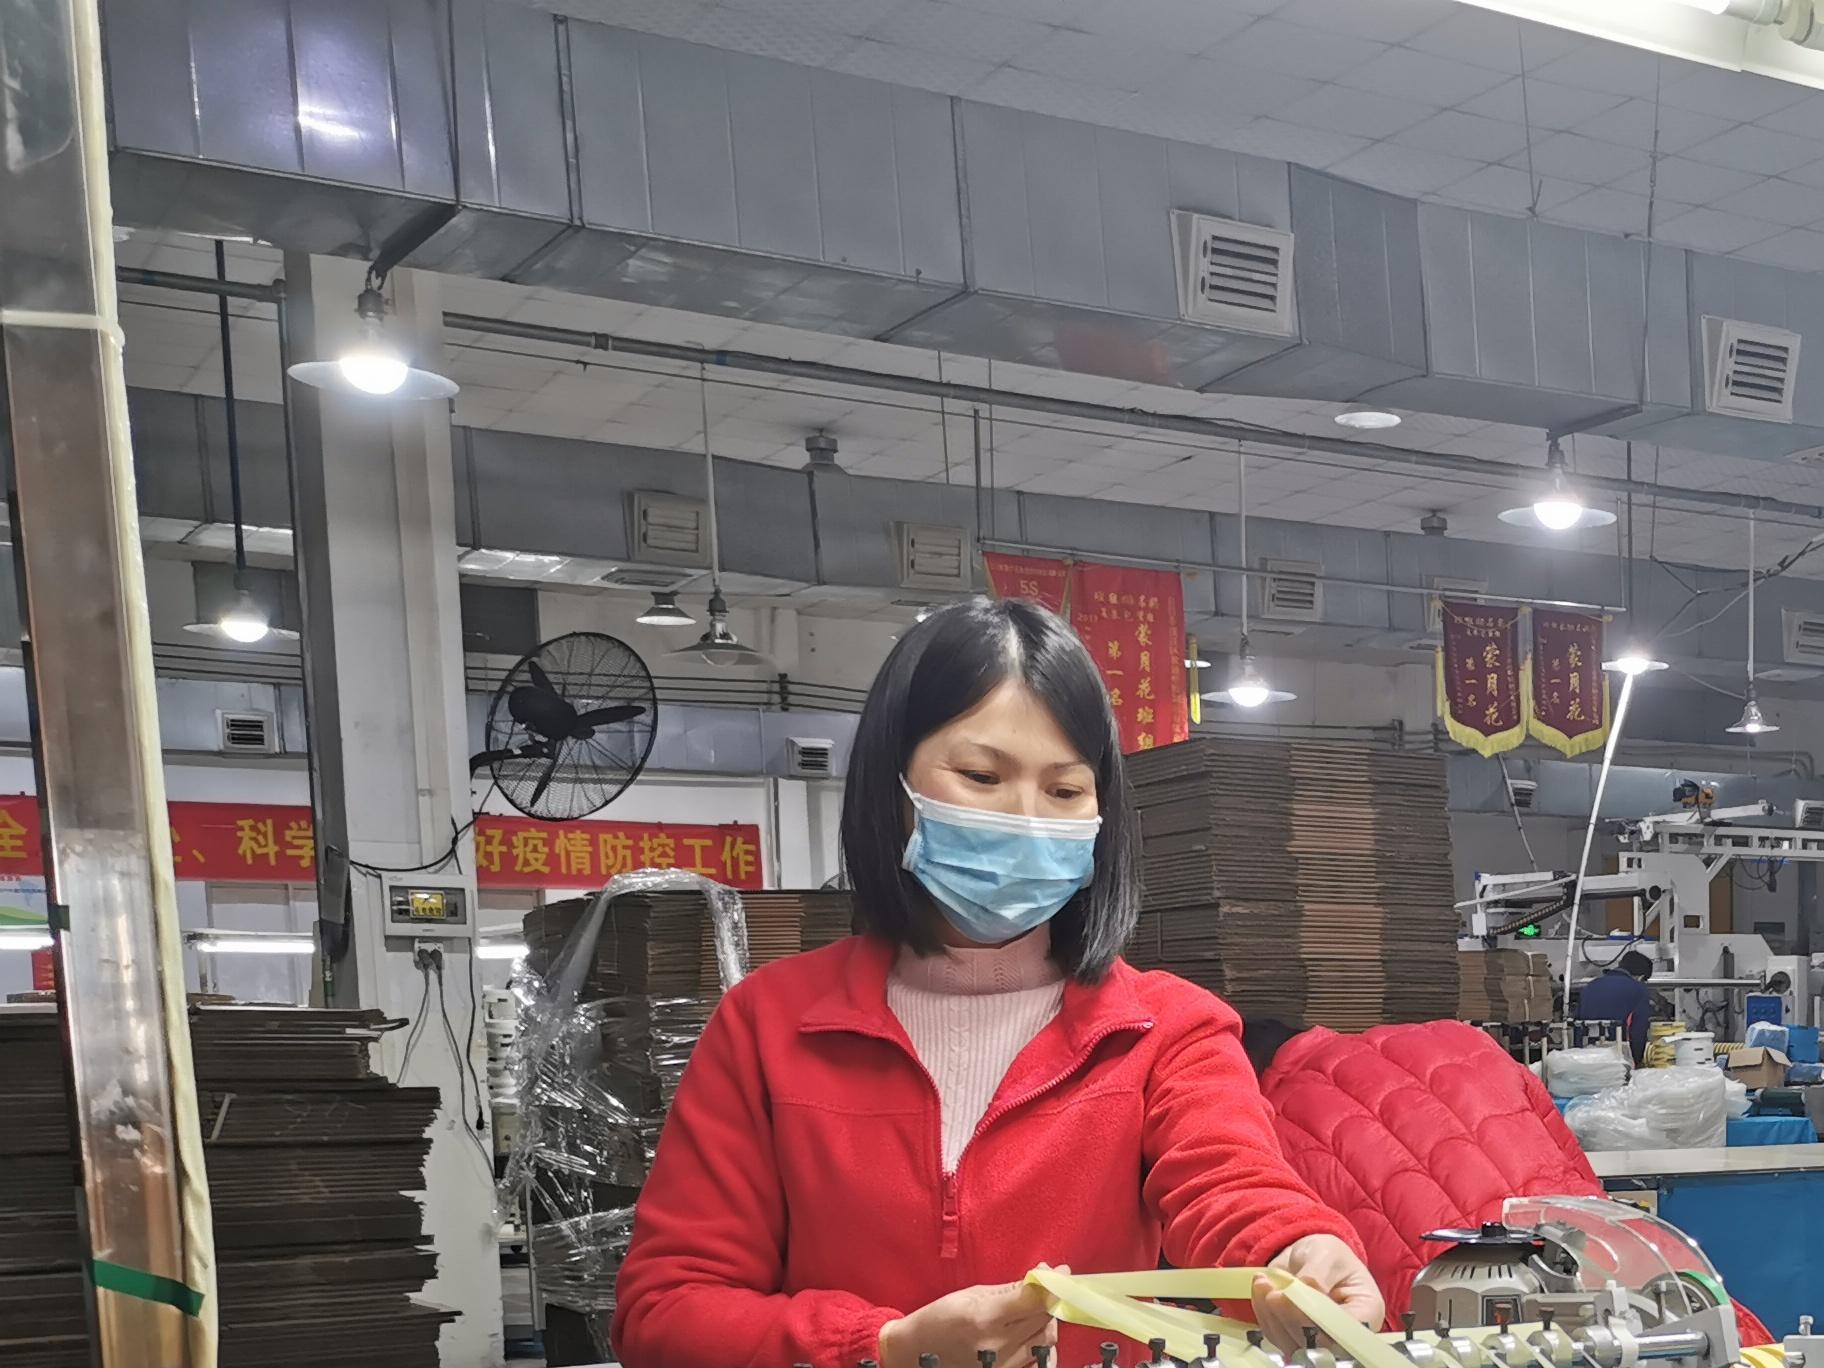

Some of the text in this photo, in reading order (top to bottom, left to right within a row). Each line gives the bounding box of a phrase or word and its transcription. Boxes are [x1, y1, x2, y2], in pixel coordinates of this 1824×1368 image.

[1020, 579, 1039, 596] 5S
[475, 828, 756, 881] 好疫情防控工作
